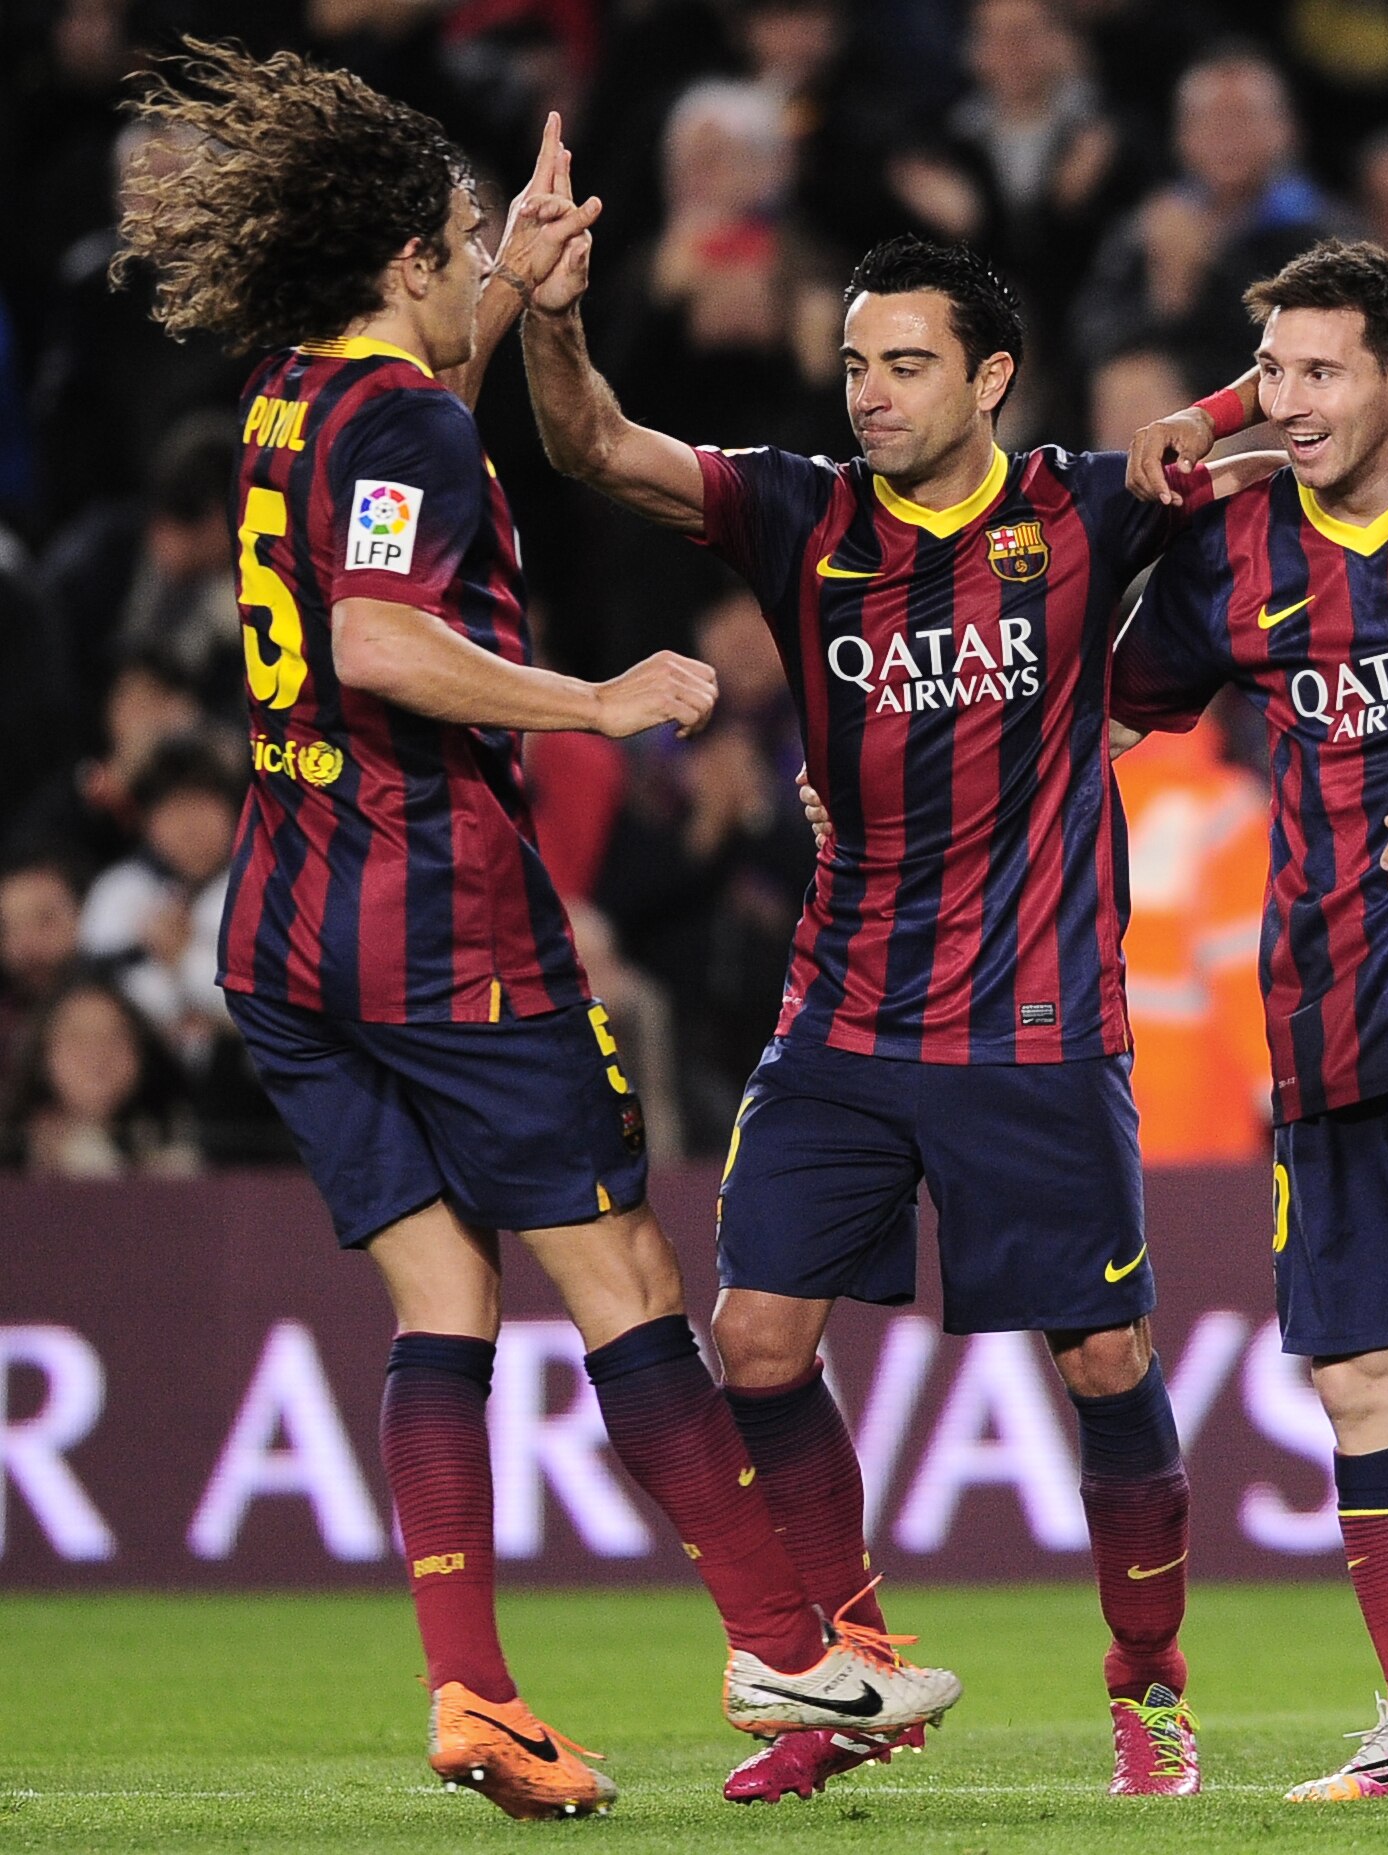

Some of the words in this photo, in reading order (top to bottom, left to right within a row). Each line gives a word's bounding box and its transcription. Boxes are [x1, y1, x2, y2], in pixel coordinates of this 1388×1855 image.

[354, 541, 402, 566] LFP
[238, 486, 308, 710] 5
[827, 617, 1039, 693] QATAR
[876, 666, 1039, 713] AIRWAYS
